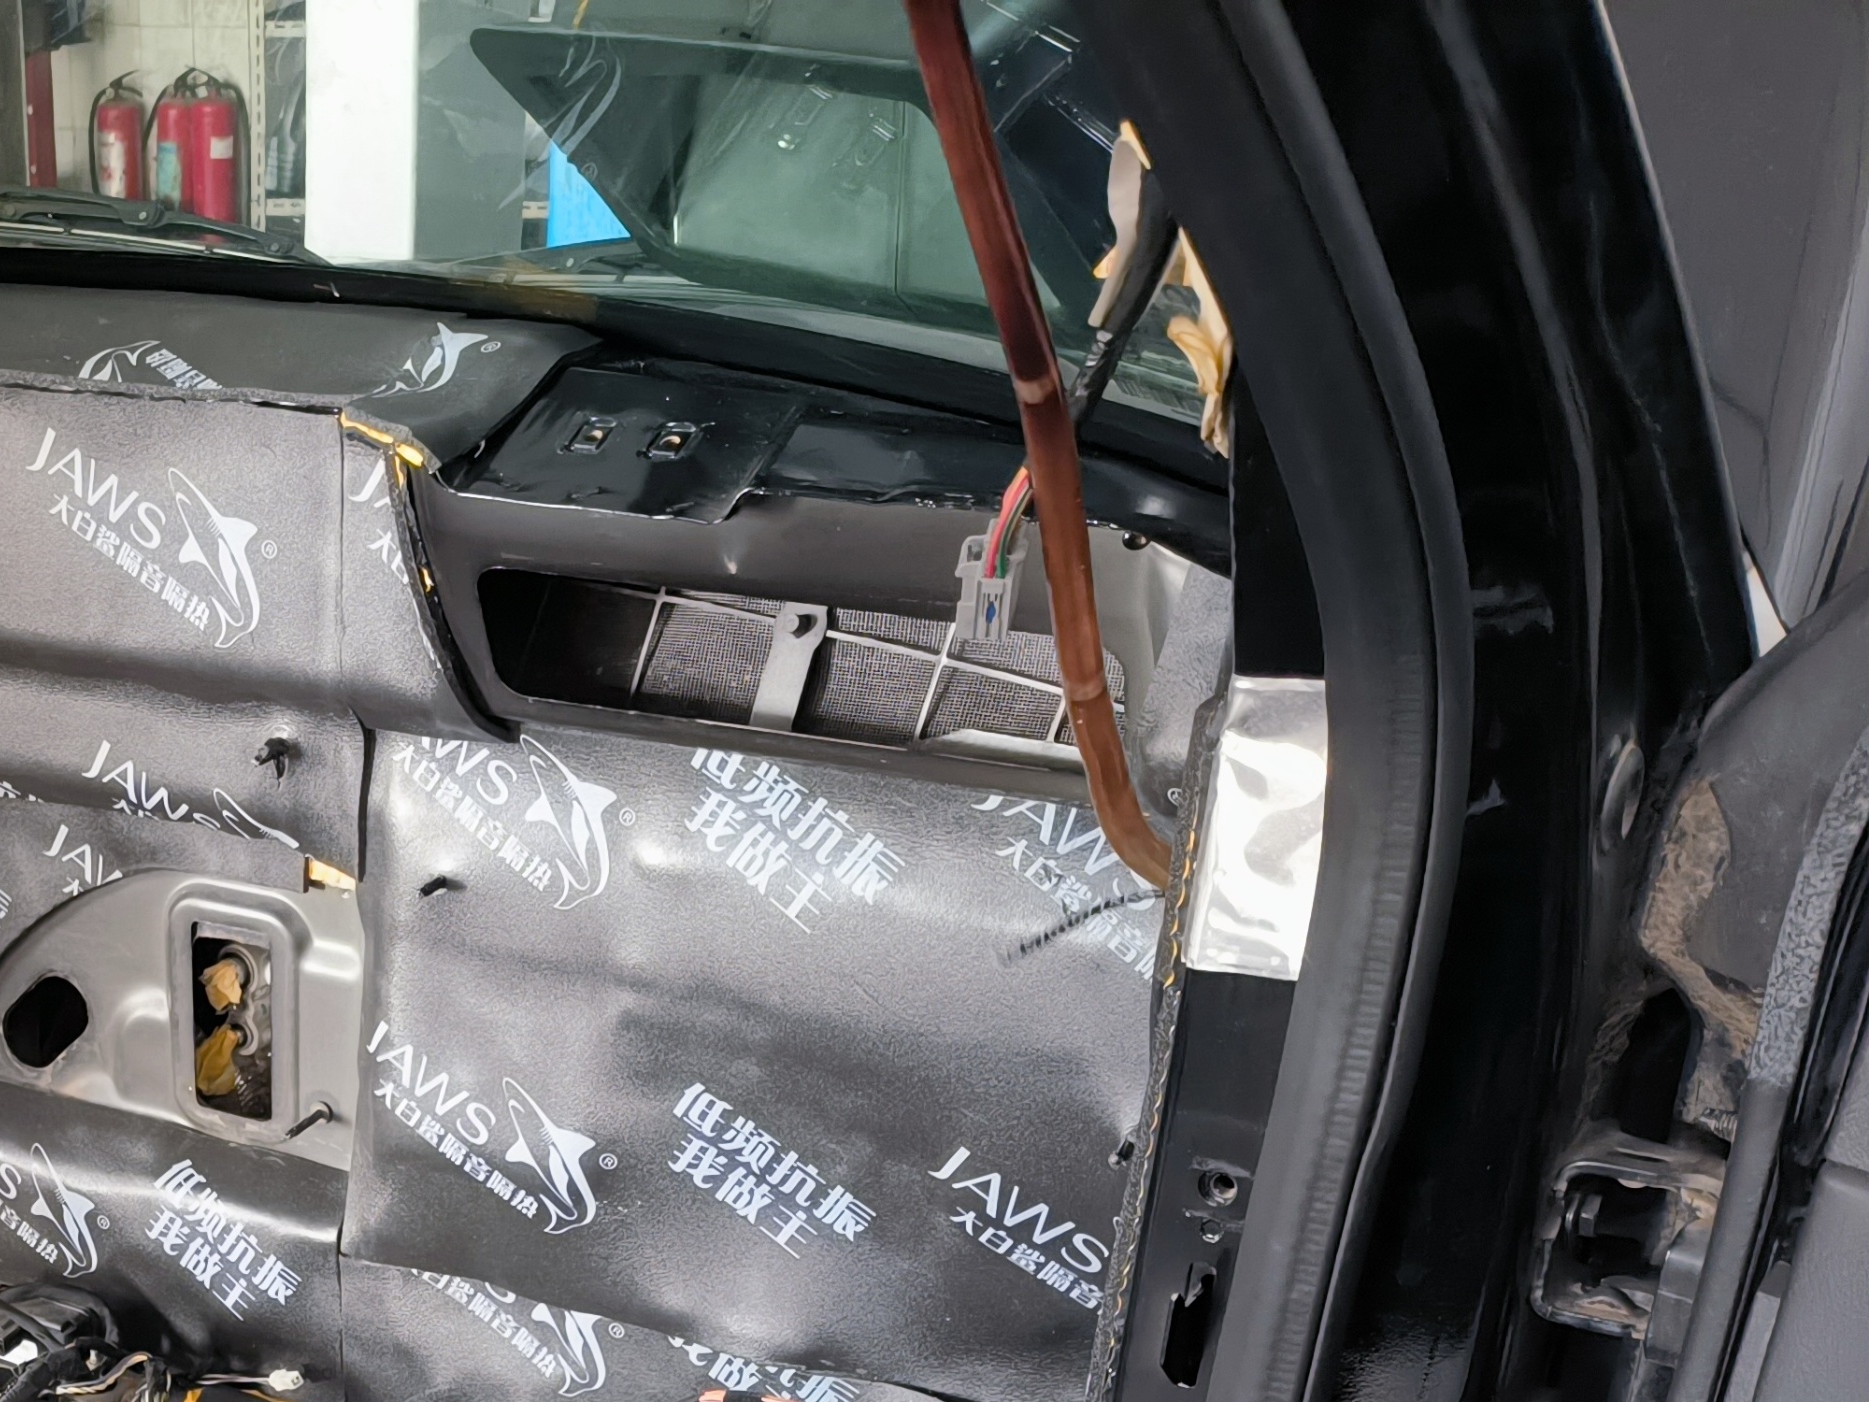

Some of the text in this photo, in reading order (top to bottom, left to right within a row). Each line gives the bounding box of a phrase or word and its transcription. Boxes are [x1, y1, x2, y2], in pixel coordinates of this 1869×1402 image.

[28, 428, 166, 548] JAWS
[49, 492, 210, 632] 大白鲨隔音隔热
[684, 786, 833, 935] 我做主
[365, 1021, 497, 1146] JAWS
[374, 1079, 539, 1218] 大白鲨隔音隔热
[669, 1135, 820, 1259] 我做主
[673, 1082, 877, 1242] 低频抗振
[927, 1146, 1110, 1274] JAWS
[144, 1207, 252, 1321] 我做主
[153, 1160, 302, 1306] 低频抗振
